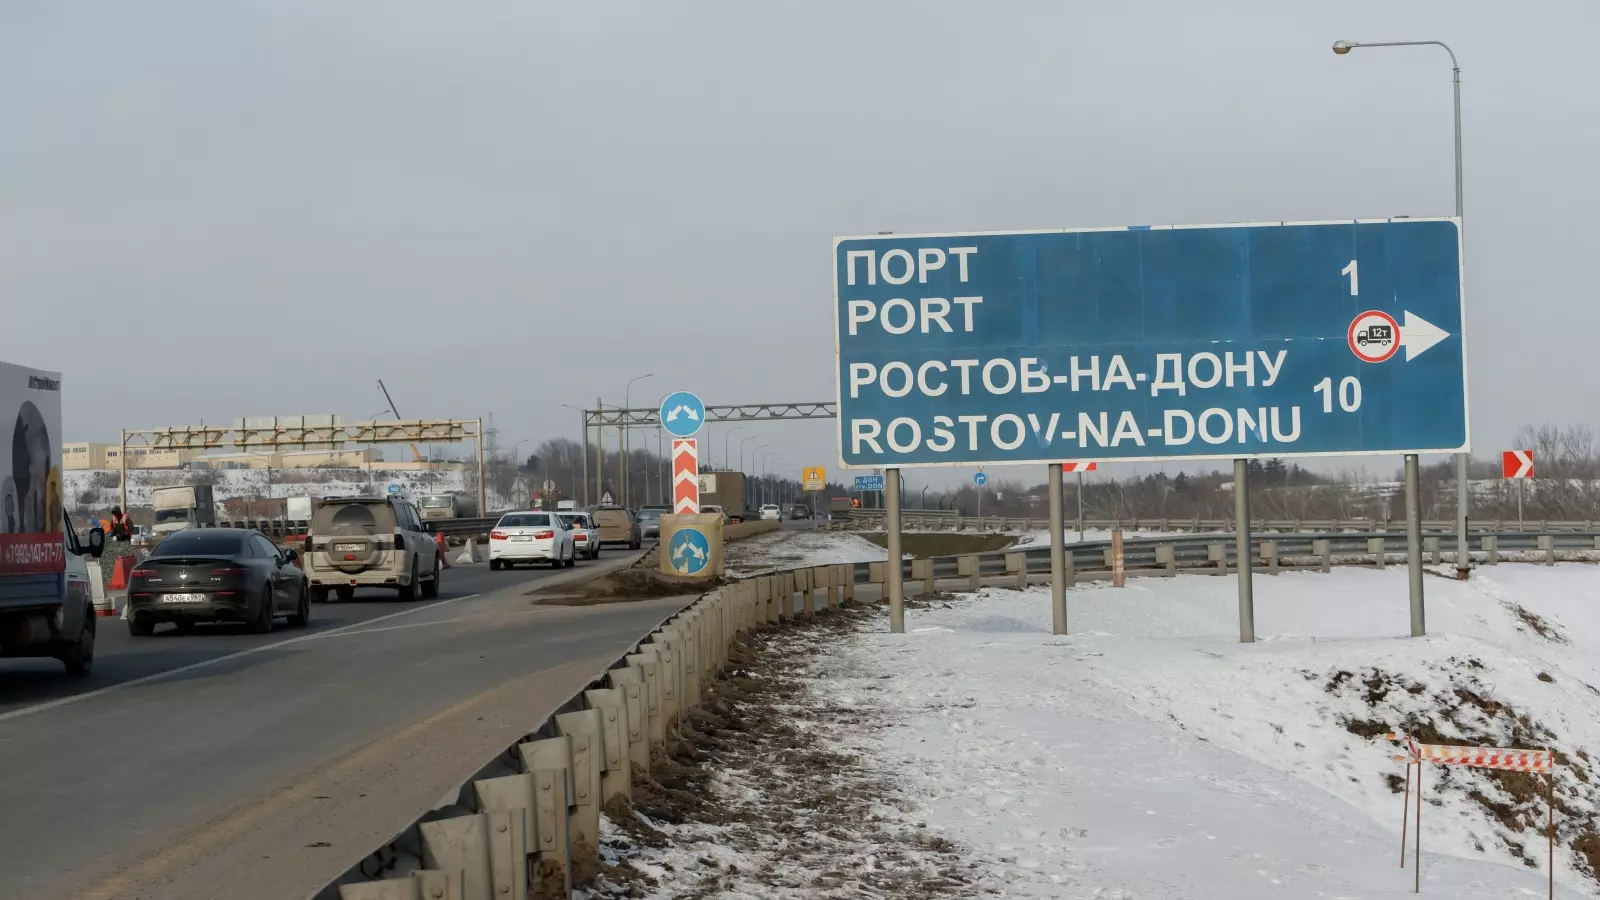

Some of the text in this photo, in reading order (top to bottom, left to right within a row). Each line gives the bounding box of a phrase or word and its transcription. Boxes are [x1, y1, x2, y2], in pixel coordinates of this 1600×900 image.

[847, 247, 978, 286] ПОРТ
[1341, 259, 1359, 296] 1
[848, 296, 983, 336] PORT
[850, 350, 1288, 398] РОСТОВ-НА-ДОНУ
[1313, 375, 1362, 413] 10
[851, 406, 1301, 454] ROSTOV-NA-DONU
[862, 476, 877, 484] ДОН
